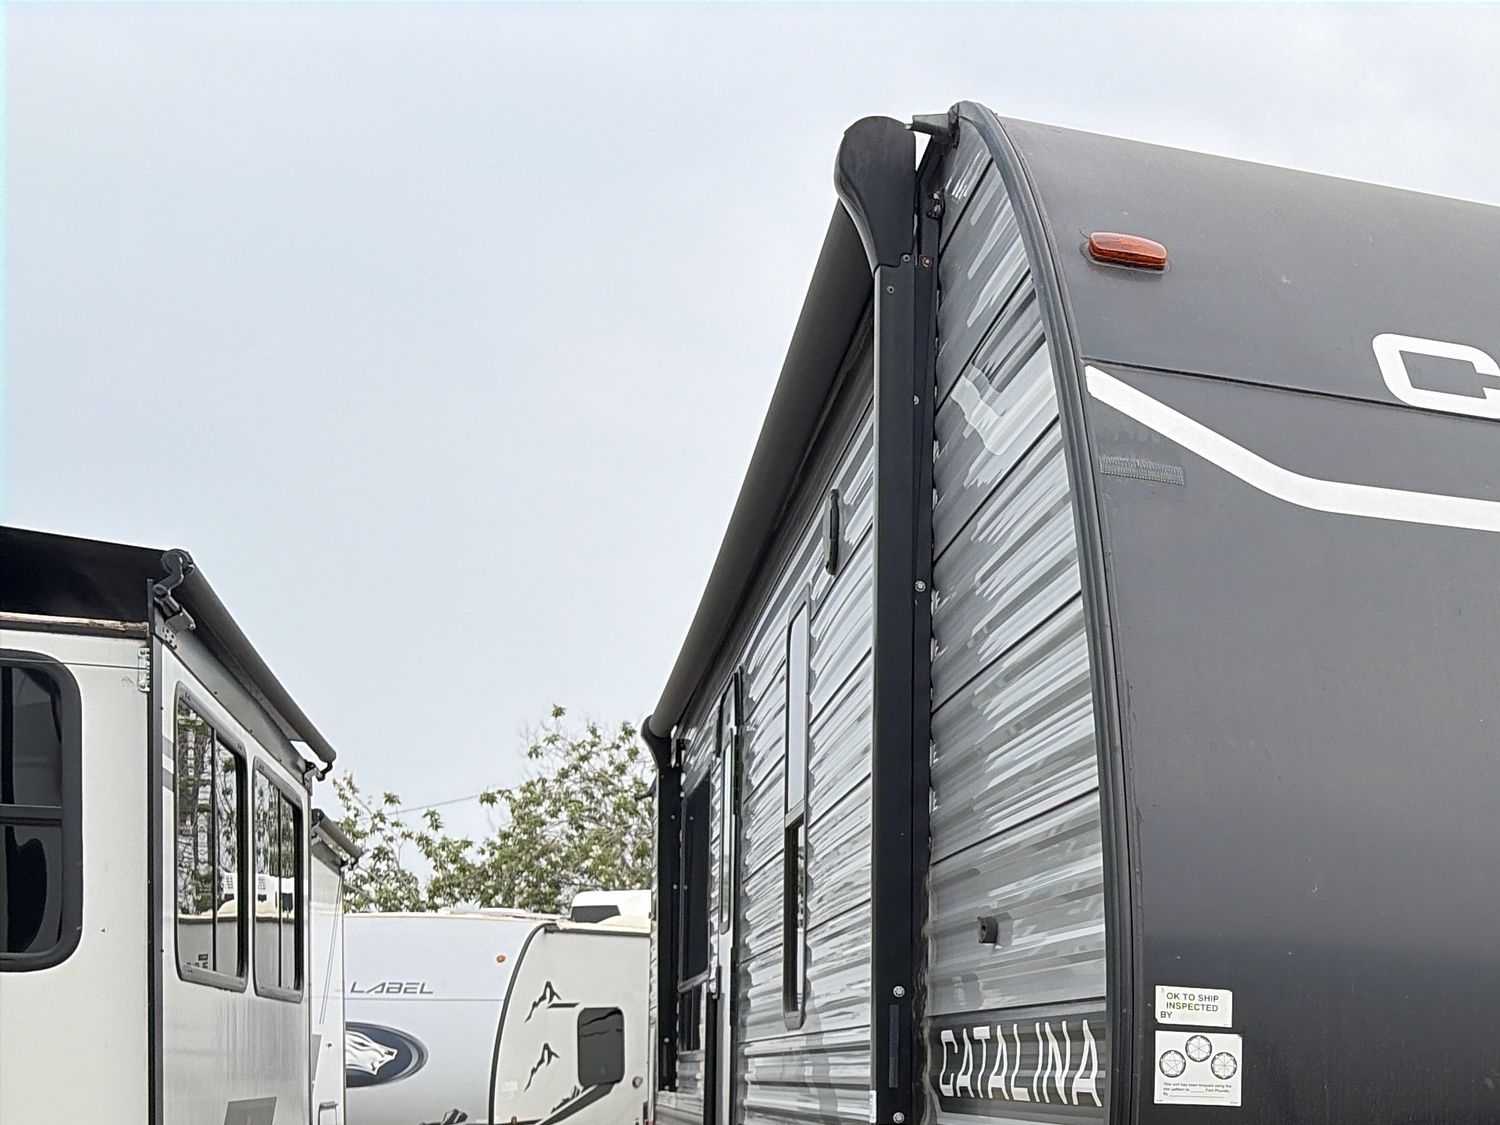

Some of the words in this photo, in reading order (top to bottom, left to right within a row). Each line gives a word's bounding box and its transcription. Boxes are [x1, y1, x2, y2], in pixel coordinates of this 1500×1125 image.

[350, 981, 434, 995] LABEL
[1166, 992, 1180, 1000] OK
[1182, 993, 1196, 1001] TO
[1198, 994, 1219, 1002] SHIP
[1166, 1002, 1219, 1012] INSPECTED
[939, 1019, 1103, 1108] CATALINA
